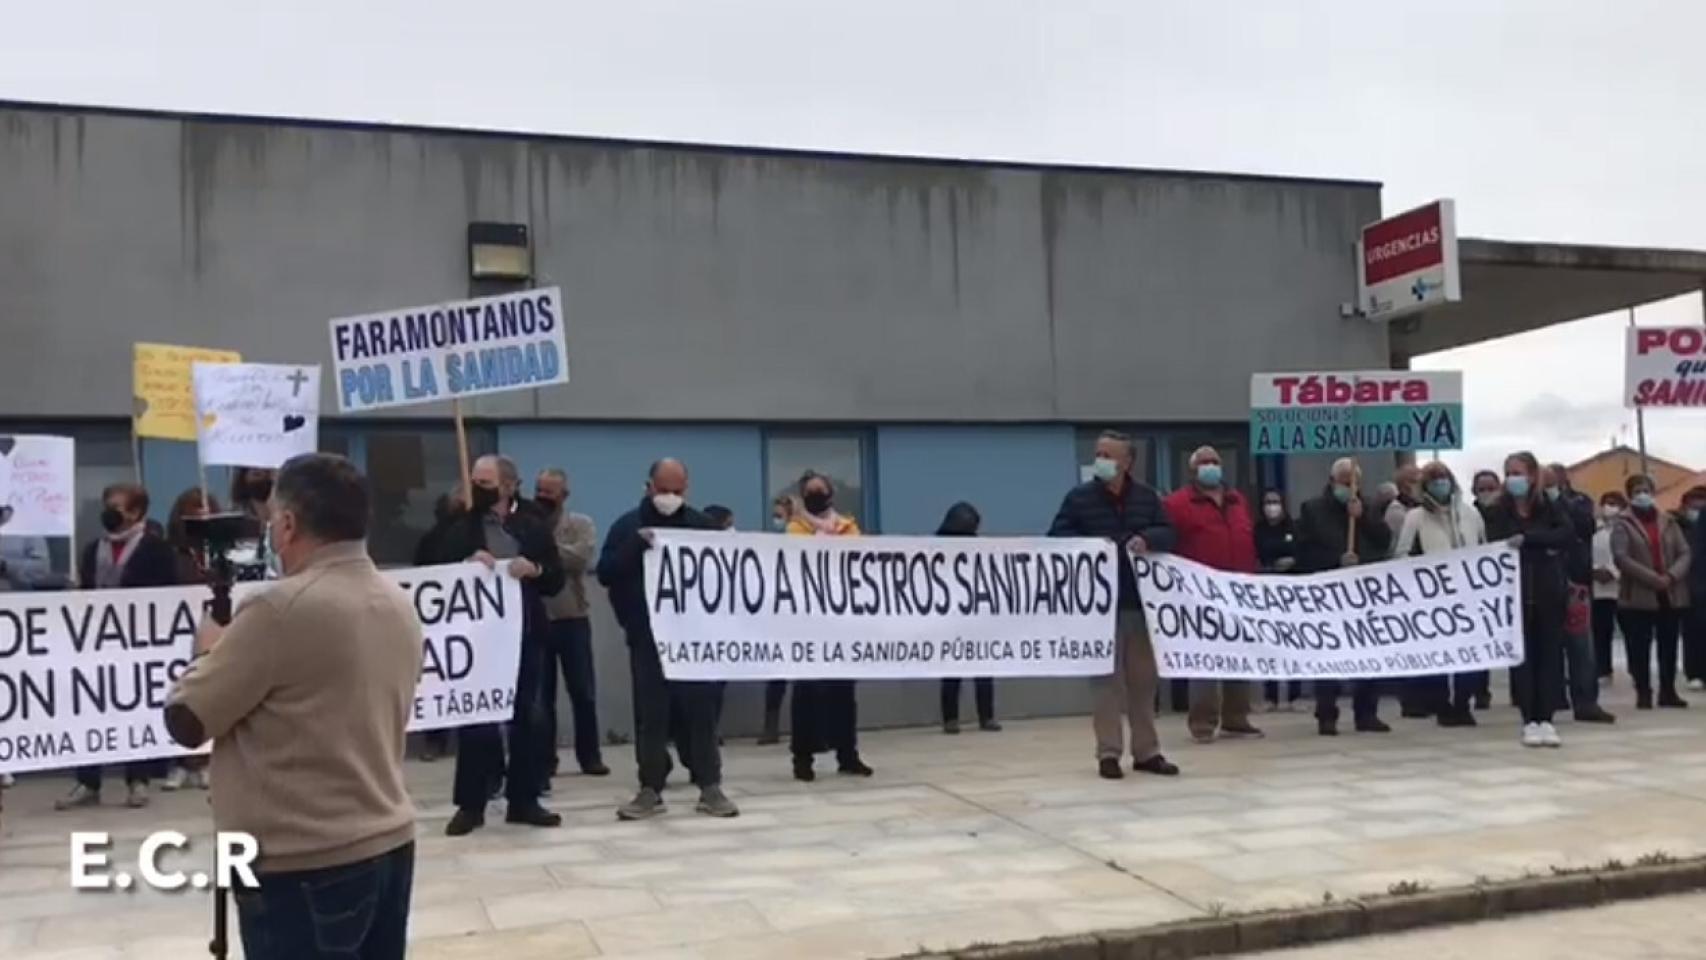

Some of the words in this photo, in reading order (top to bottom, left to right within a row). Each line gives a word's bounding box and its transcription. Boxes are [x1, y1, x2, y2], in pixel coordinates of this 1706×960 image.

[1367, 226, 1439, 264] URGENCIAS
[336, 296, 554, 361] FARAMONTANOS
[1637, 328, 1706, 356] PO
[341, 363, 394, 407] POR
[402, 357, 438, 399] LA
[445, 340, 559, 393] SANIDAD
[1675, 360, 1706, 378] qu
[1273, 375, 1429, 405] Tábara
[1633, 378, 1706, 406] SANI
[1257, 408, 1351, 423] SOLUCIONES
[1257, 426, 1271, 450] A
[1280, 426, 1305, 449] LA
[1313, 423, 1412, 449] SANIDAD
[1412, 409, 1456, 446] YA
[654, 544, 765, 614] APOYO
[773, 548, 798, 615] A
[800, 549, 950, 616] NUESTROS
[953, 551, 1113, 616] SANITARIOS
[1133, 556, 1193, 595] POR
[1191, 572, 1229, 605] LA
[1229, 571, 1411, 614] REAPERTURA
[1413, 564, 1458, 600] DE
[61, 599, 197, 653] VALLA
[399, 574, 505, 625] GAN
[1342, 602, 1476, 650] MÉDICOS
[791, 641, 815, 662] DE
[823, 641, 844, 662] LA
[851, 640, 934, 663] SANIDAD
[940, 636, 1014, 662] PÚBLICA
[1020, 639, 1043, 660] DE
[1256, 657, 1277, 675] DE
[1283, 657, 1304, 676] LA
[1305, 656, 1382, 678] SANIDAD
[1384, 652, 1456, 671] PÚBLICA
[1458, 646, 1483, 664] DE
[86, 726, 118, 752] DE
[129, 724, 157, 749] LA
